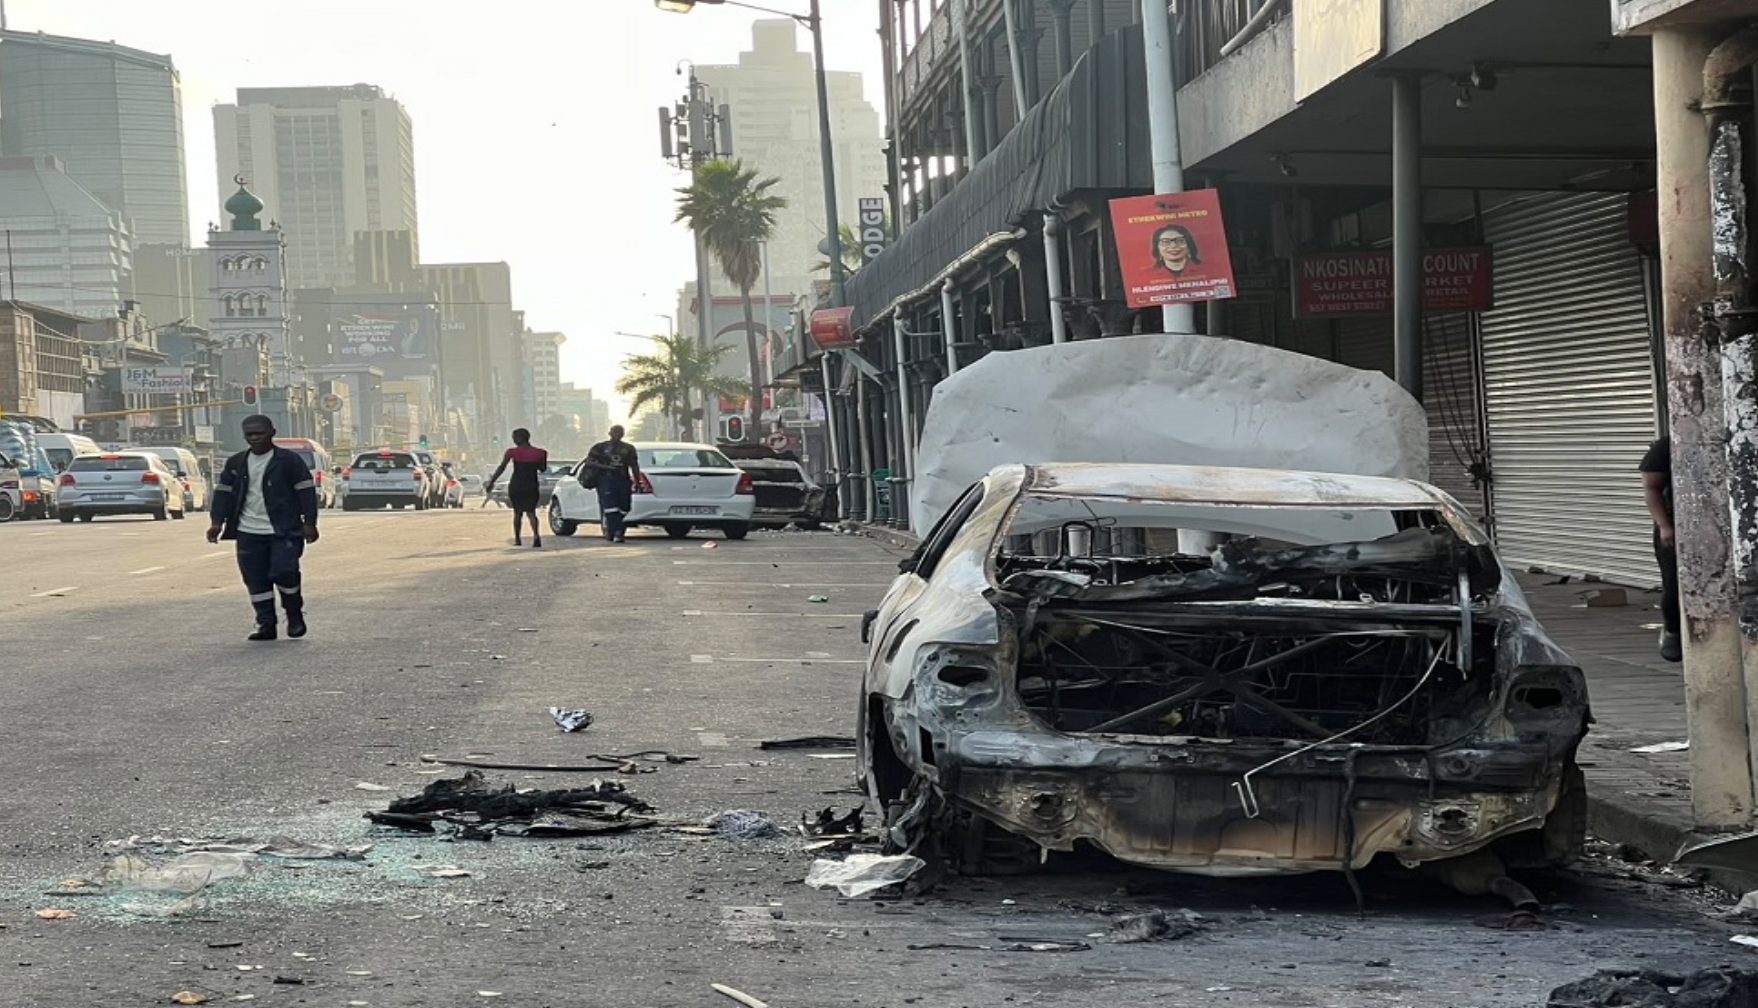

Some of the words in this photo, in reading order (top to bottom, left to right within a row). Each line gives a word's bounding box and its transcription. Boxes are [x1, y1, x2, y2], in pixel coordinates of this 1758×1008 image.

[1178, 210, 1208, 219] METRO
[861, 199, 884, 259] ODGE
[1303, 257, 1390, 278] NKOSINATI
[1423, 253, 1480, 273] COUNT
[1311, 279, 1388, 292] SUPEER
[1424, 275, 1475, 287] RKET
